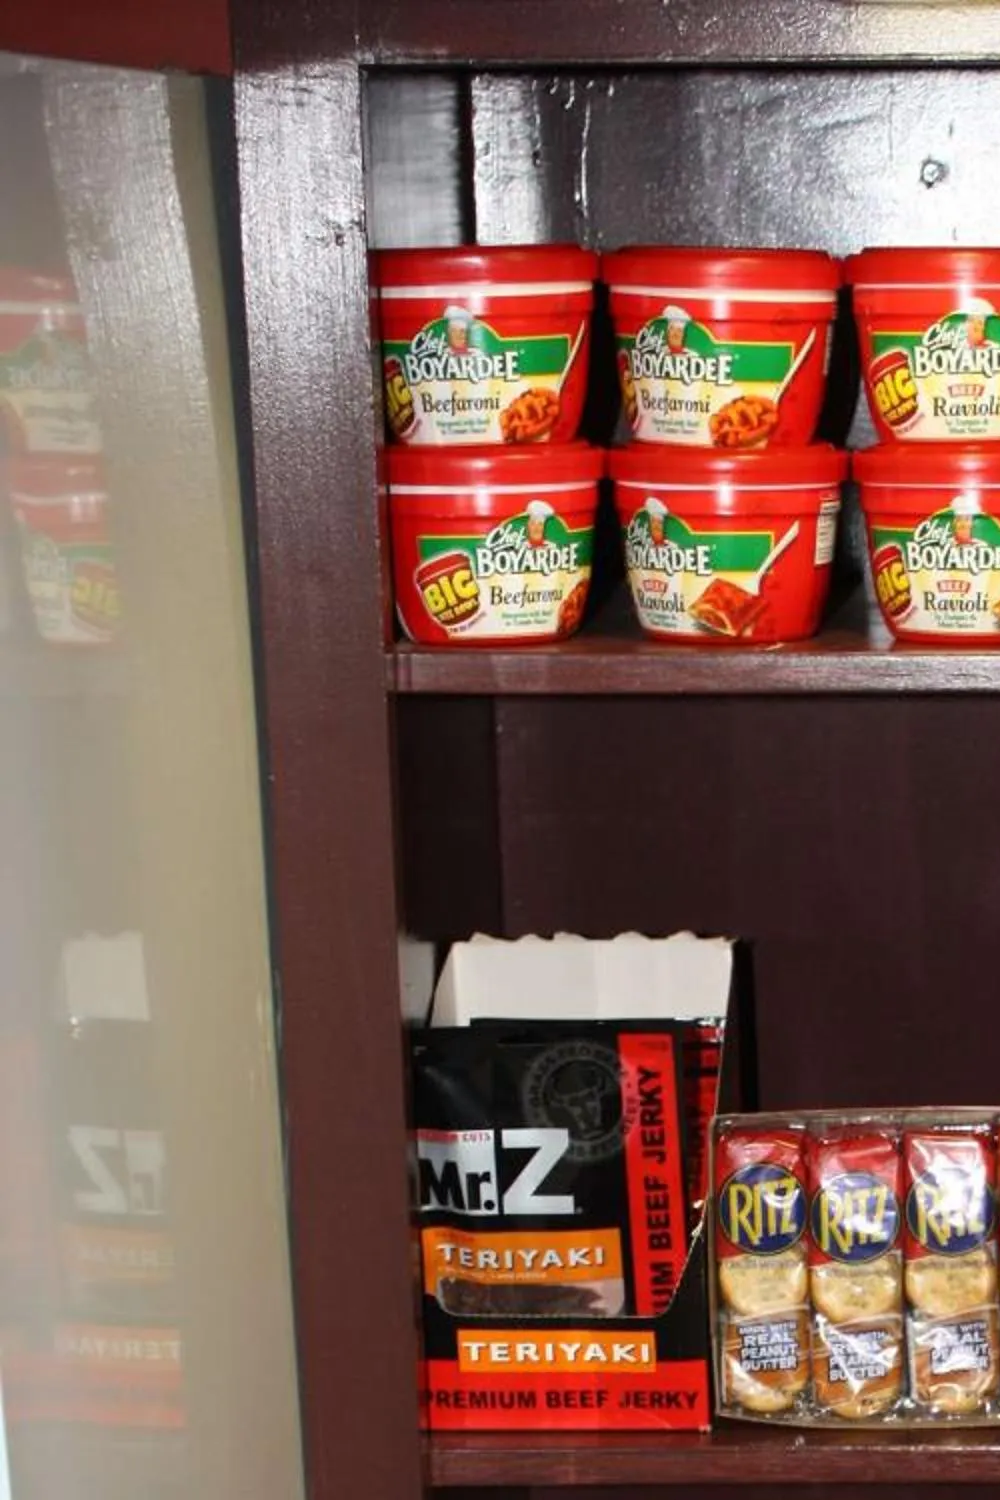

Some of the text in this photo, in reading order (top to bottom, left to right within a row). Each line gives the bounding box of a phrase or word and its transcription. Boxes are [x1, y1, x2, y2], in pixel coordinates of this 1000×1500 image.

[412, 330, 447, 355] Chef
[404, 350, 521, 386] BOYARDEE
[632, 349, 734, 386] BOYARDEE
[421, 391, 501, 416] Beefaroni
[641, 388, 711, 415] Beefaroni
[875, 367, 917, 413] BIG
[933, 395, 1000, 418] Ravioli
[486, 523, 527, 550] Chef
[913, 518, 952, 546] Chef
[476, 542, 581, 579] BOYARDEE
[423, 569, 479, 614] BIG
[490, 584, 564, 609] Beefaroni
[923, 591, 989, 613] Ravioli
[637, 1065, 666, 1164] JERKY
[644, 1174, 674, 1250] BEEF
[728, 1176, 797, 1247] RITZ
[819, 1184, 888, 1254] RITZ
[915, 1182, 985, 1247] RZ
[436, 1242, 606, 1270] TERIYAKI
[741, 1343, 799, 1359] PEANUT
[742, 1331, 793, 1347] REAL
[463, 1341, 650, 1365] TERIYAKI
[741, 1357, 797, 1372] BUTTER
[422, 1390, 699, 1411] PREMIUM BEEF JERKY
